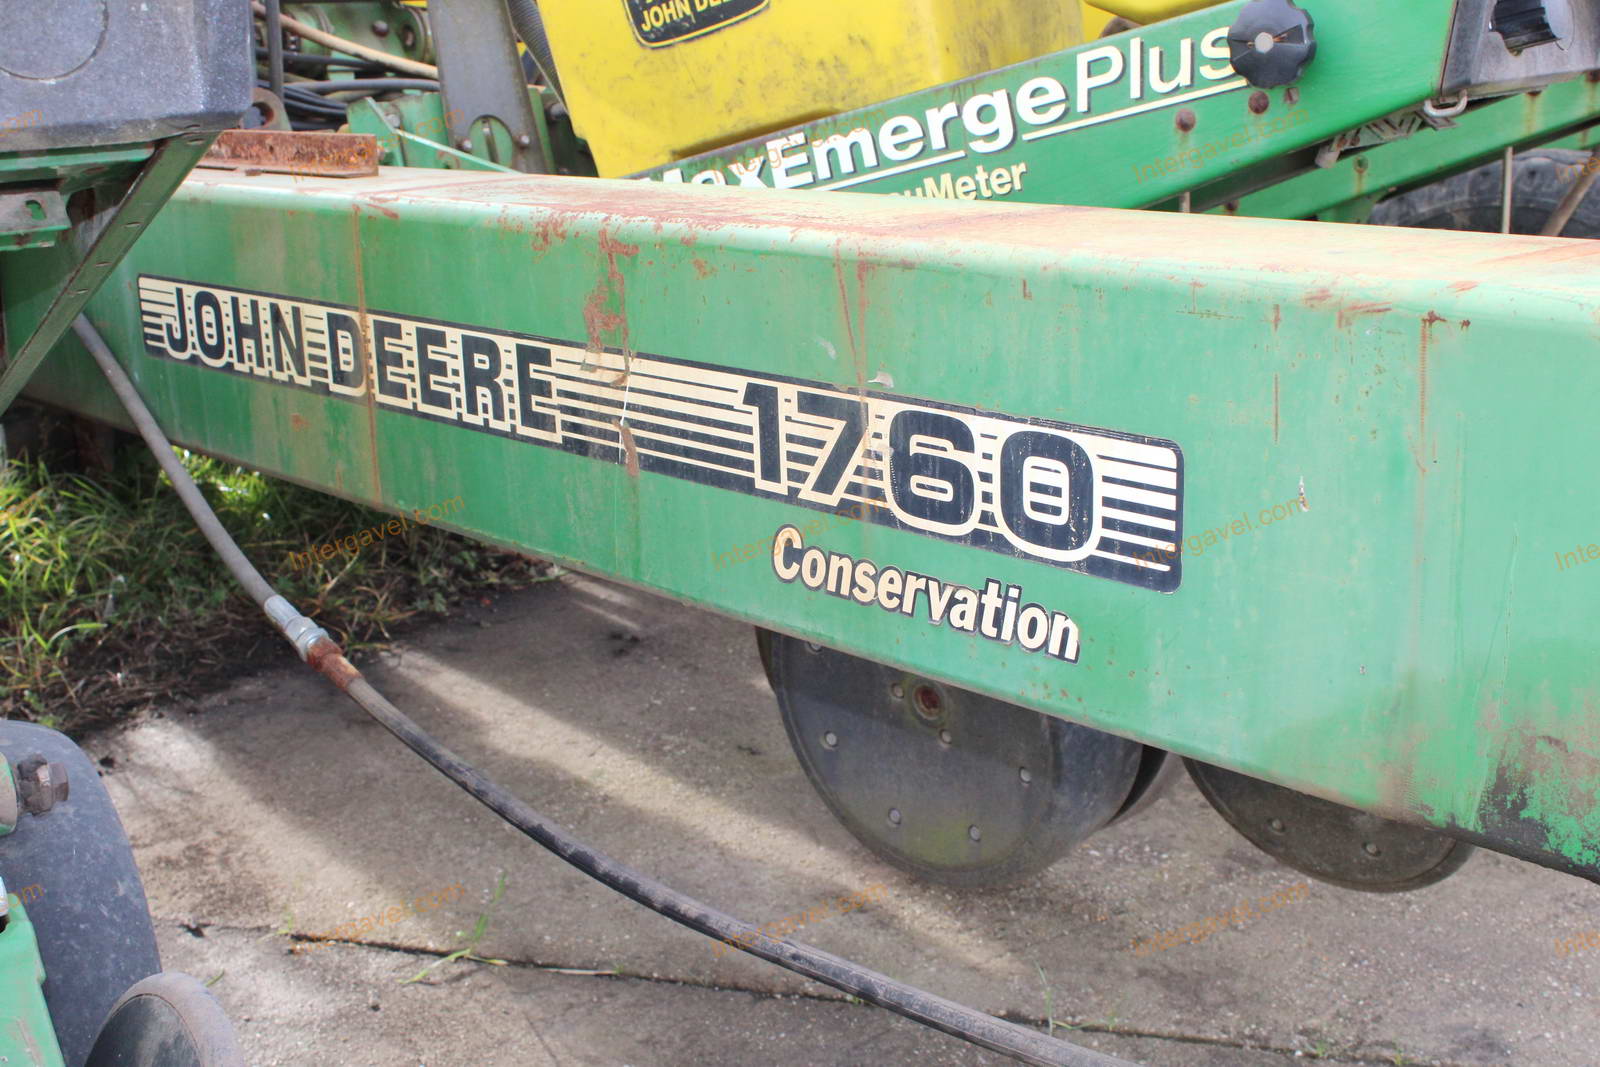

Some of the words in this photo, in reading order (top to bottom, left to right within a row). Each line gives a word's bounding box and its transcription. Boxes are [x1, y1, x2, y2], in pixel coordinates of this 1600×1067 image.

[641, 0, 693, 32] JOHN
[162, 284, 312, 387] JOHN
[325, 310, 563, 444] DEERE
[741, 381, 1101, 562] 1760
[772, 524, 1080, 663] Conservation
